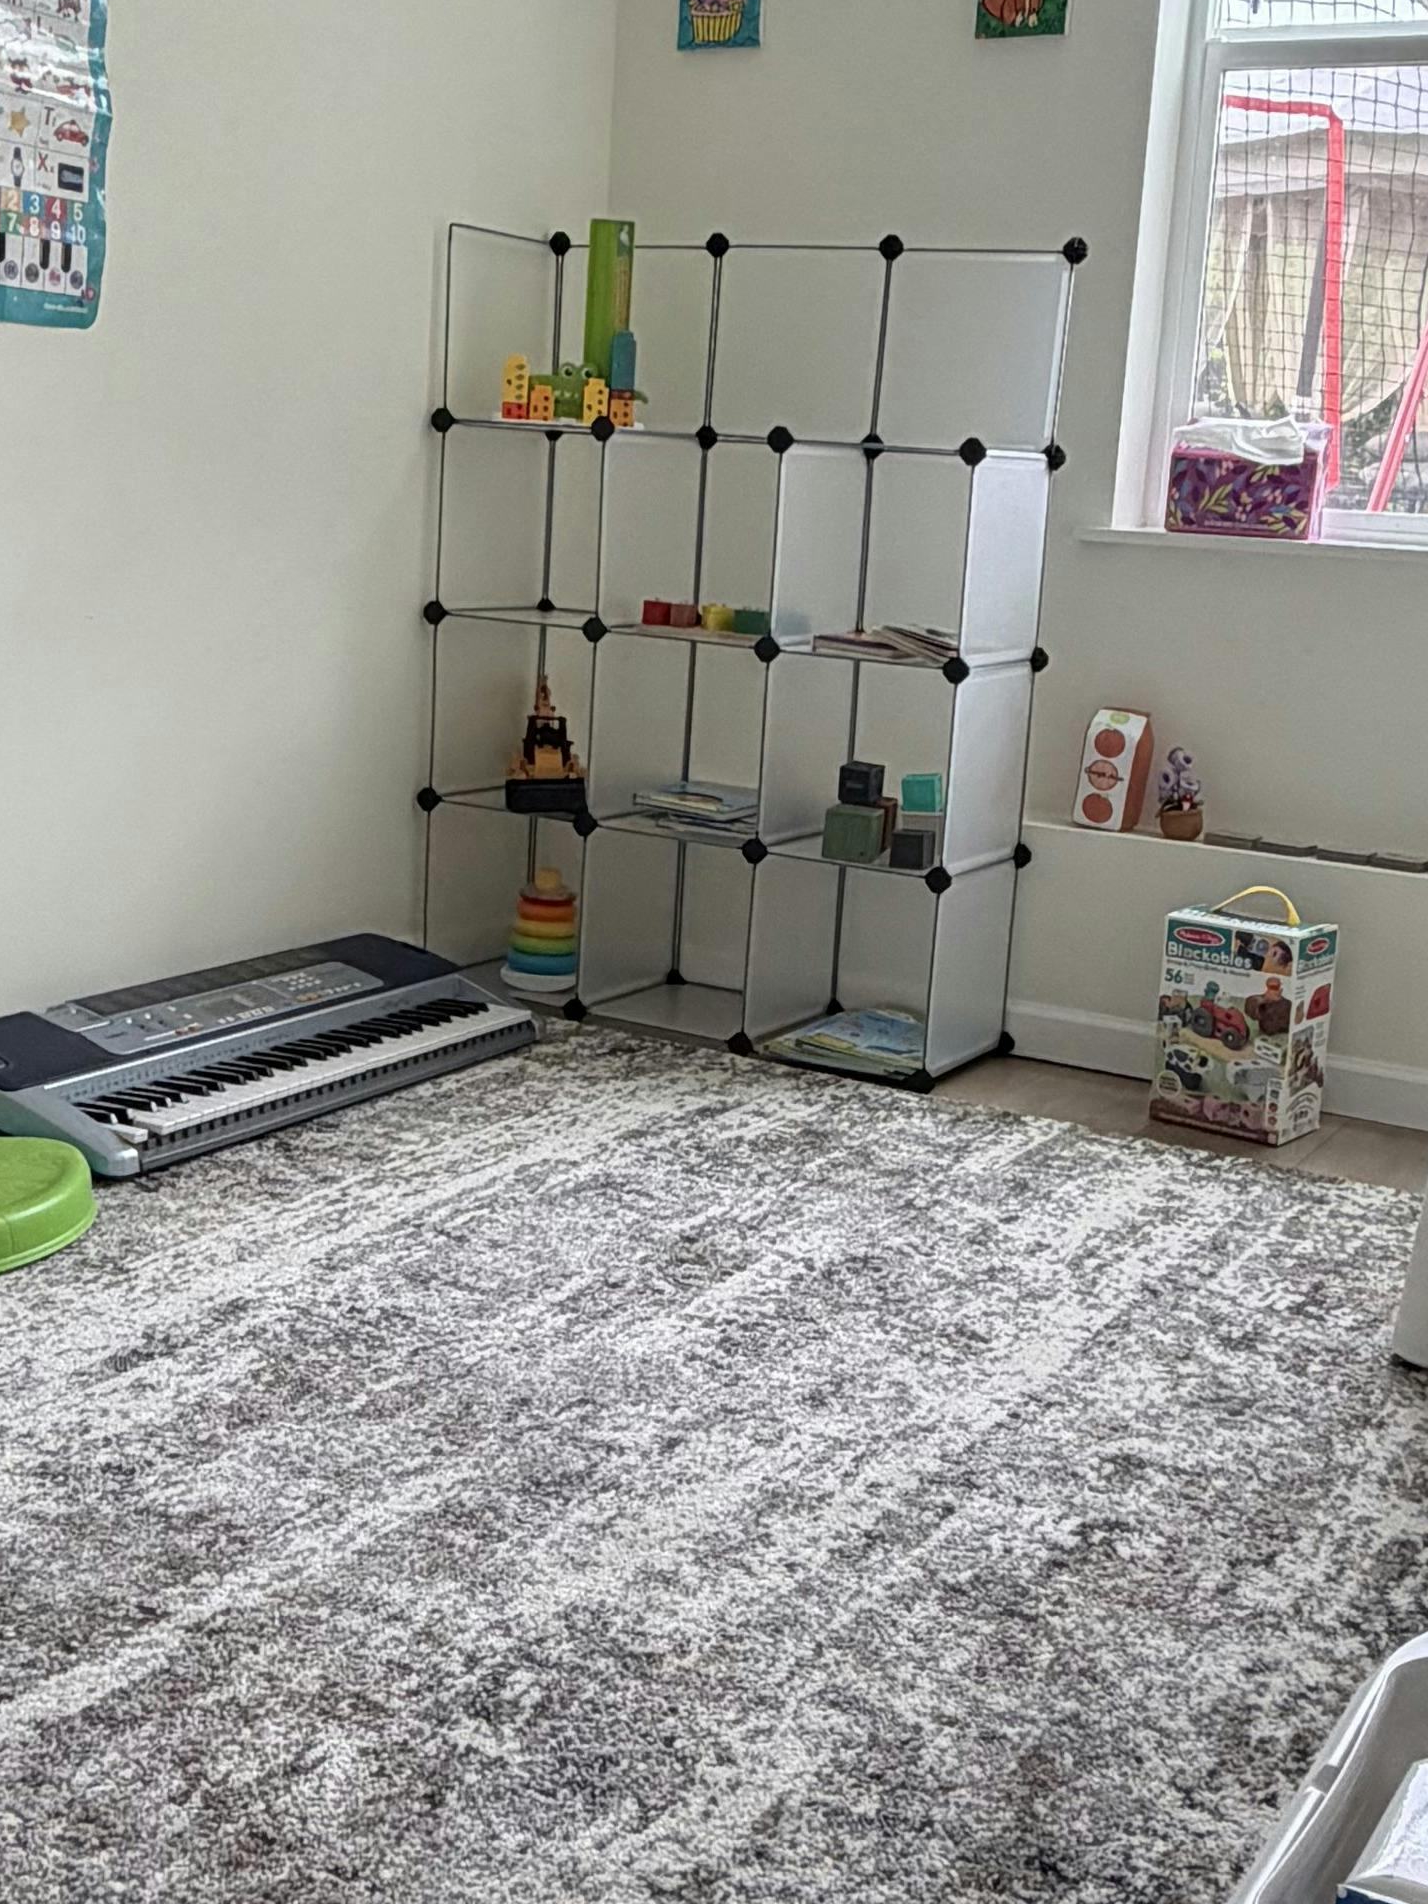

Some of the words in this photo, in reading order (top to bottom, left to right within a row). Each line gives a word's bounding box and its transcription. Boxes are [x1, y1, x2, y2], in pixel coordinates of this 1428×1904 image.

[29, 194, 40, 214] 3
[51, 198, 62, 220] 4
[73, 202, 84, 222] 5
[6, 212, 18, 232] 7
[29, 216, 40, 237] 8
[50, 220, 62, 240] 9
[70, 223, 86, 245] 10
[1167, 940, 1252, 969] Blockables
[1164, 967, 1184, 984] 56
